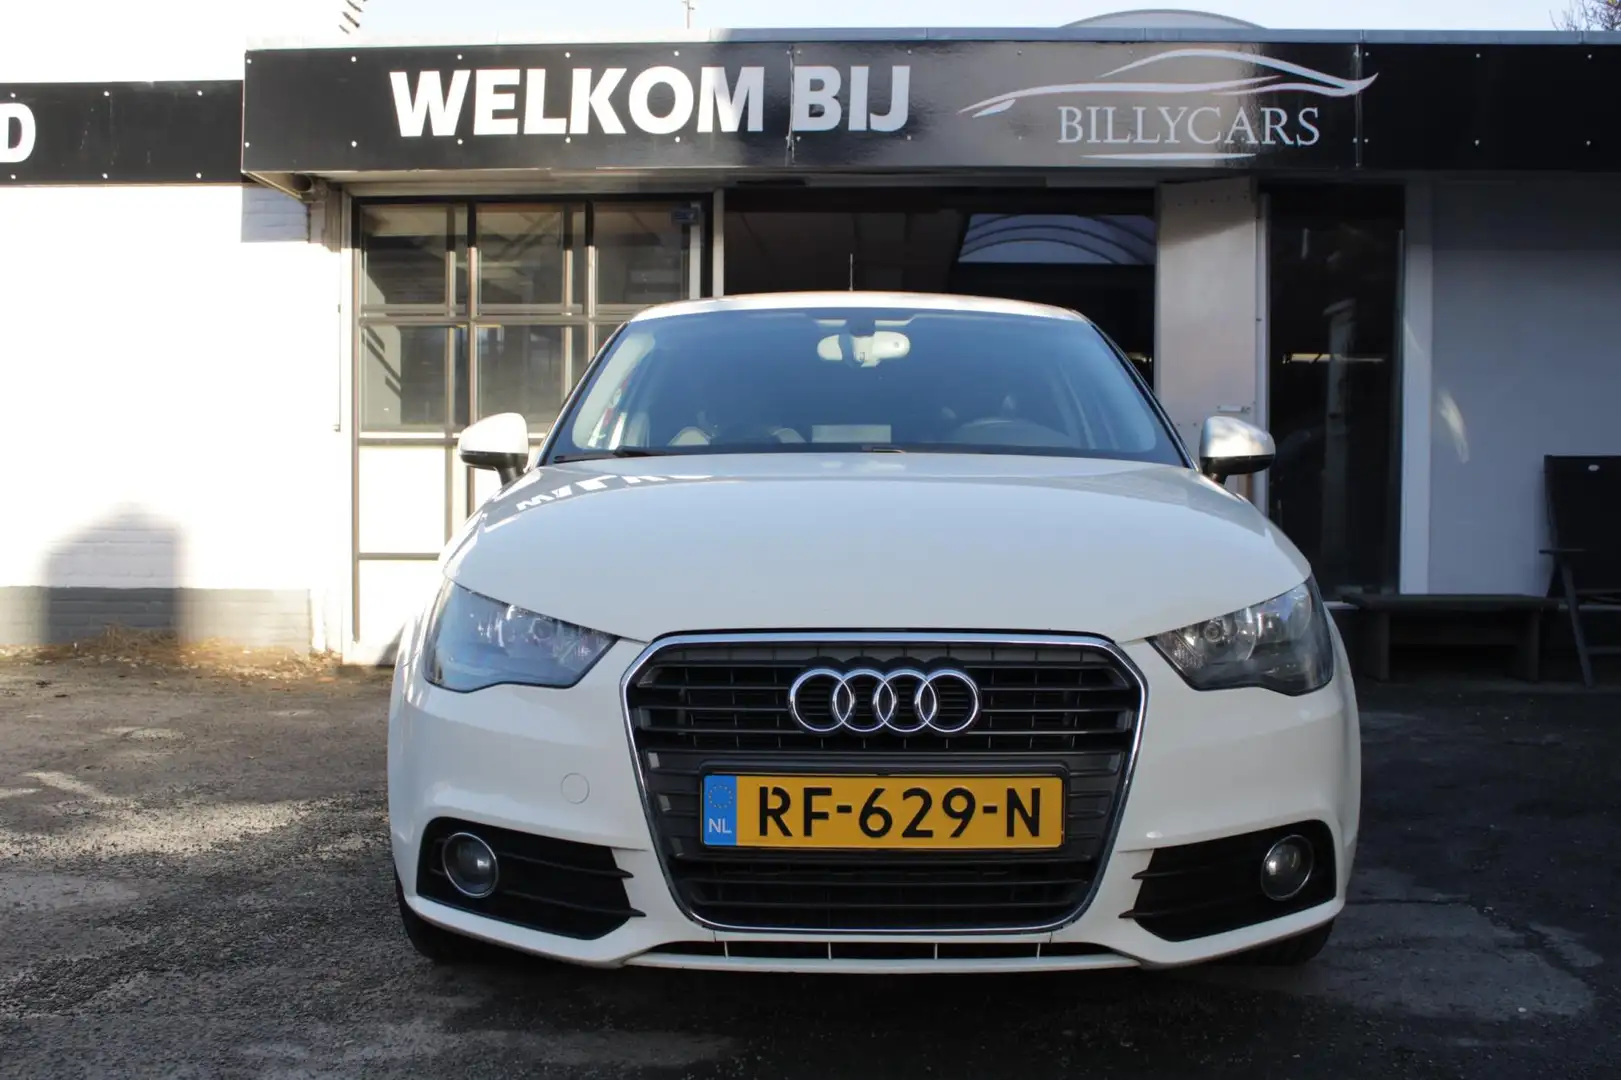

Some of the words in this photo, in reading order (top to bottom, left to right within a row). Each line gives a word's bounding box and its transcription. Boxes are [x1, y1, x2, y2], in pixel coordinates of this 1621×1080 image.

[389, 66, 764, 137] WELKOM
[790, 65, 910, 131] BIJ
[1057, 106, 1319, 146] BILLYCARS
[708, 818, 732, 834] NL
[759, 786, 1041, 838] RF-629-N
